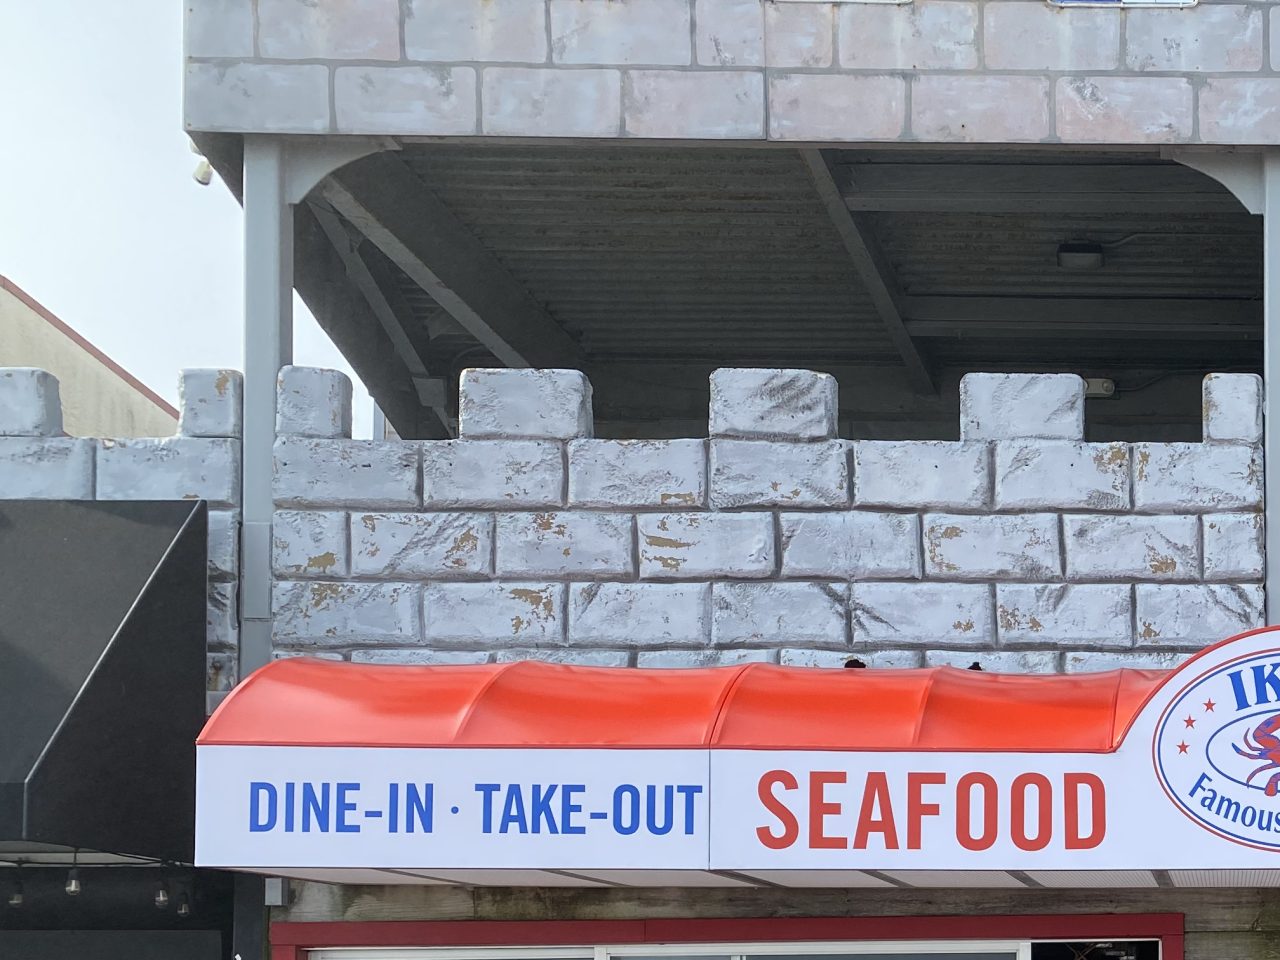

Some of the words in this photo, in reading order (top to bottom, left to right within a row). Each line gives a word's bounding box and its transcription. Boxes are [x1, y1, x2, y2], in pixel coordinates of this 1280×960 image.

[249, 781, 434, 834] DINE-IN
[475, 783, 703, 835] TAKE-OUT
[756, 769, 1106, 851] SEAFOOD
